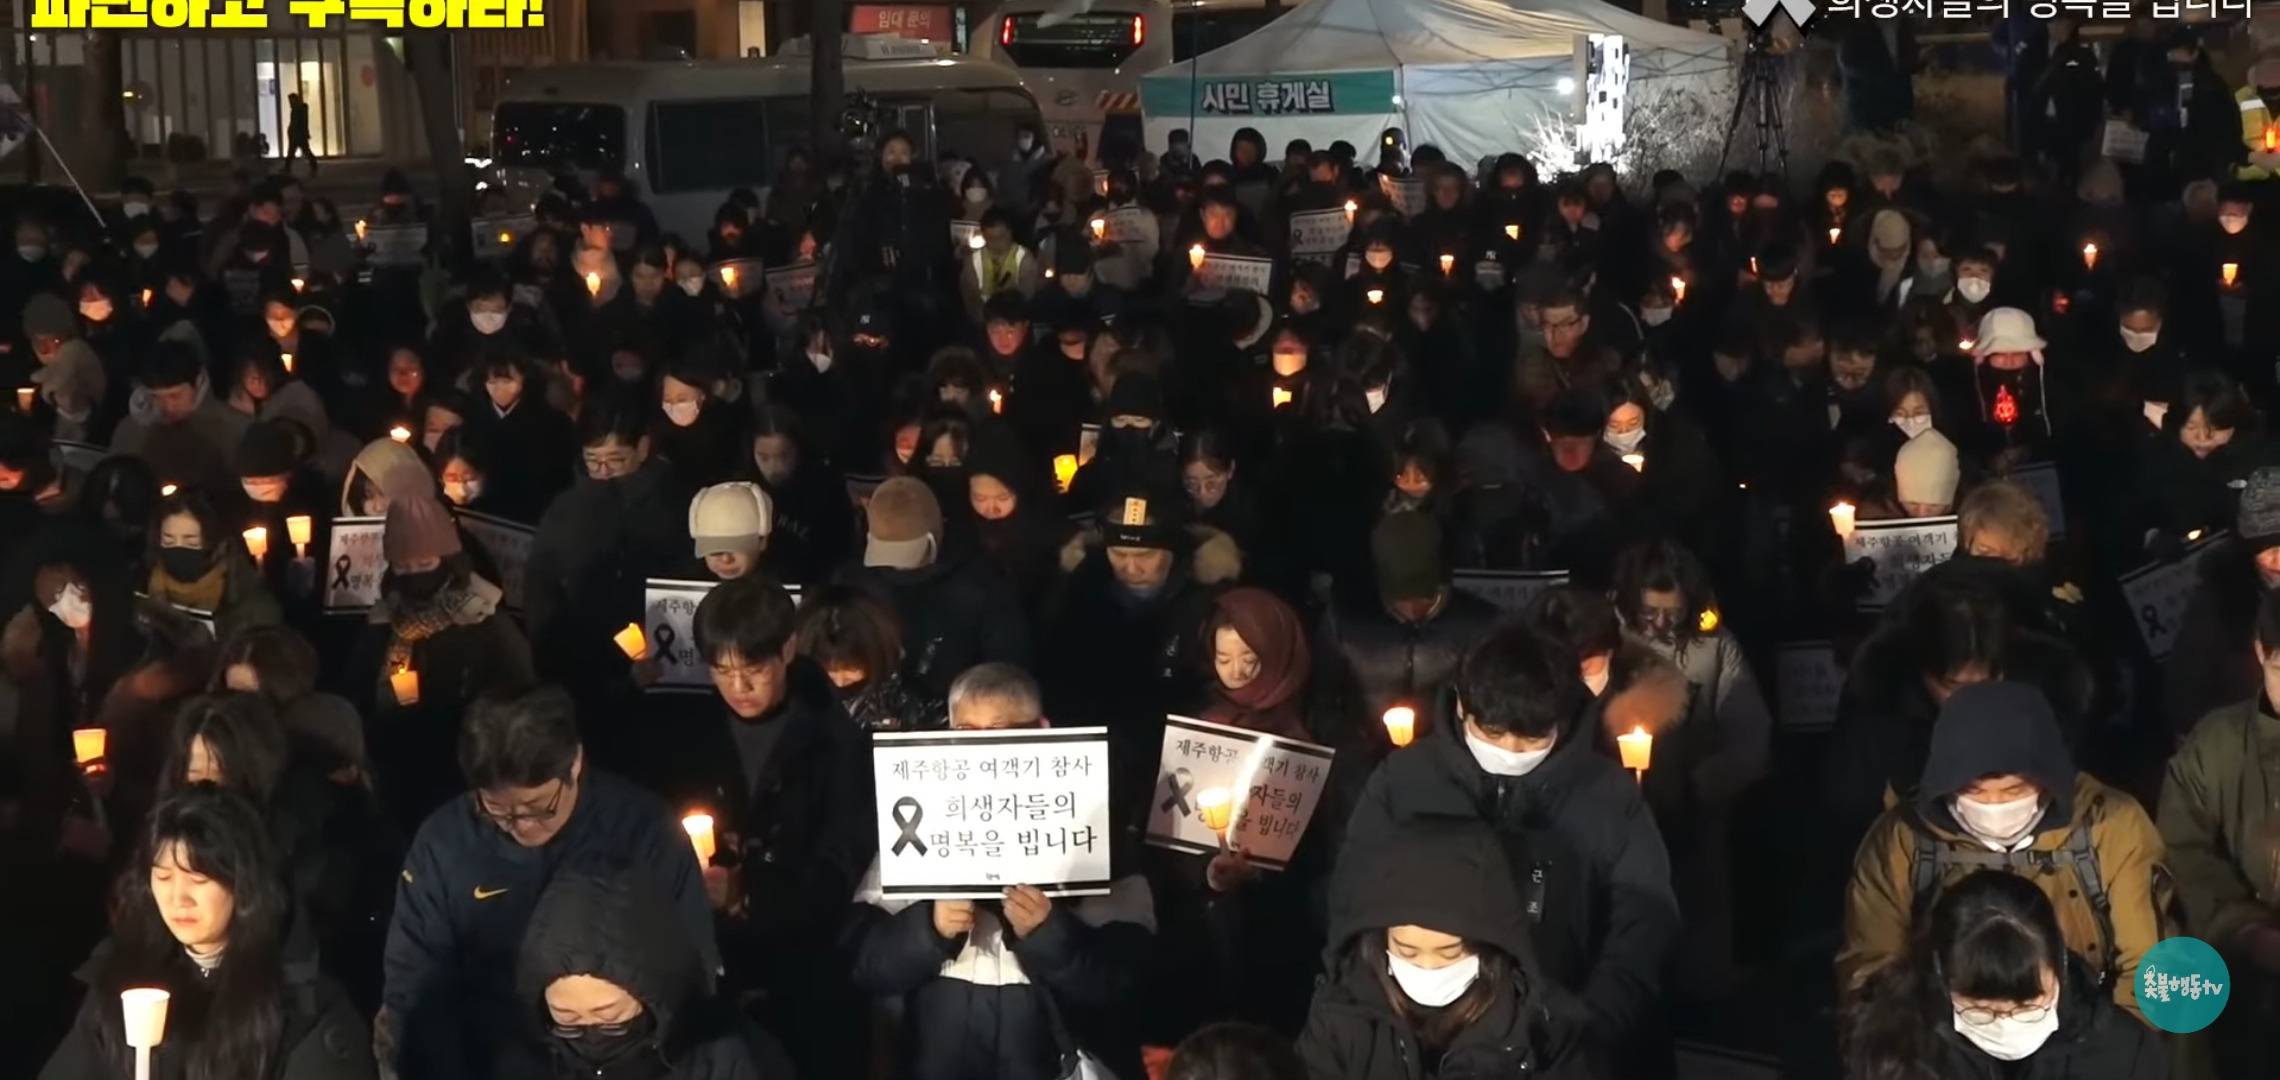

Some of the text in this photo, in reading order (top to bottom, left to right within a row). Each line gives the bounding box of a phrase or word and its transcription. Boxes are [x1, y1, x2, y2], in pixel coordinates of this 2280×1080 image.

[879, 10, 931, 29] 임대 문의
[1202, 80, 1334, 113] 시민 휴게실
[893, 755, 1094, 781] 제주항공 여객기 참사
[945, 791, 1076, 823] 희생자들의
[930, 824, 1099, 858] 명복을 빕니다
